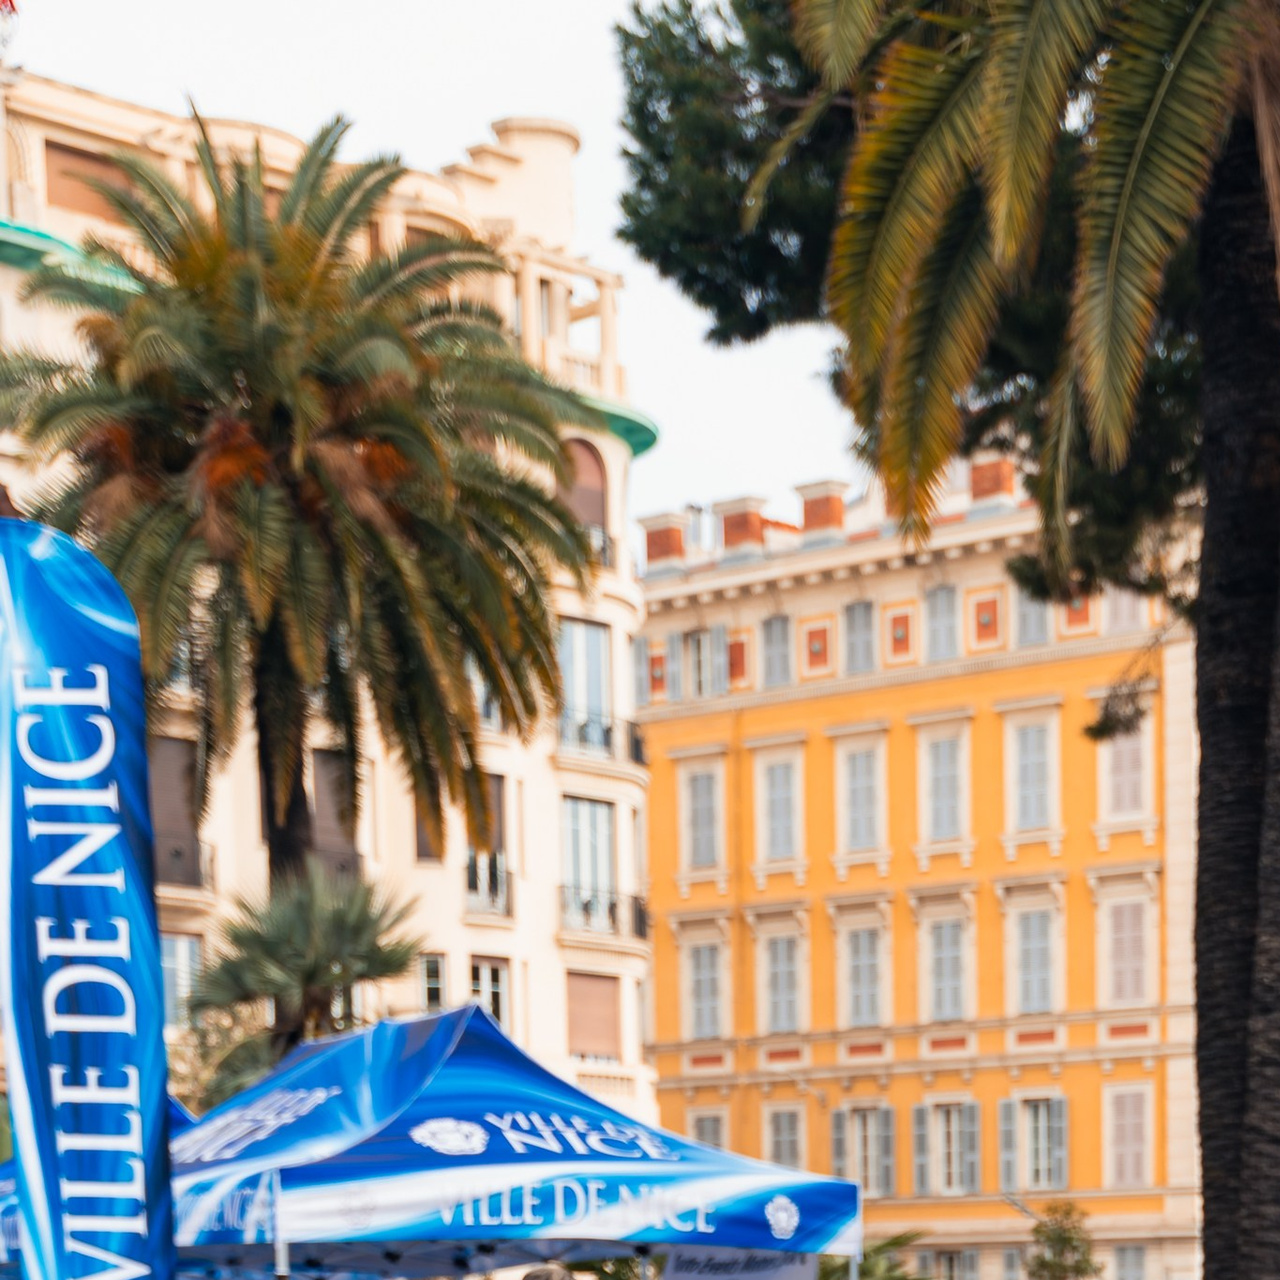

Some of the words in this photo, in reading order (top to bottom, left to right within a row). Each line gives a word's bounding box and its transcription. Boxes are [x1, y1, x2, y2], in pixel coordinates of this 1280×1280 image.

[12, 663, 126, 894] NICE
[35, 916, 137, 1038] DE
[502, 1129, 681, 1161] NICE
[438, 1182, 544, 1226] VILLE
[552, 1178, 607, 1225] DE
[617, 1183, 716, 1233] NICE
